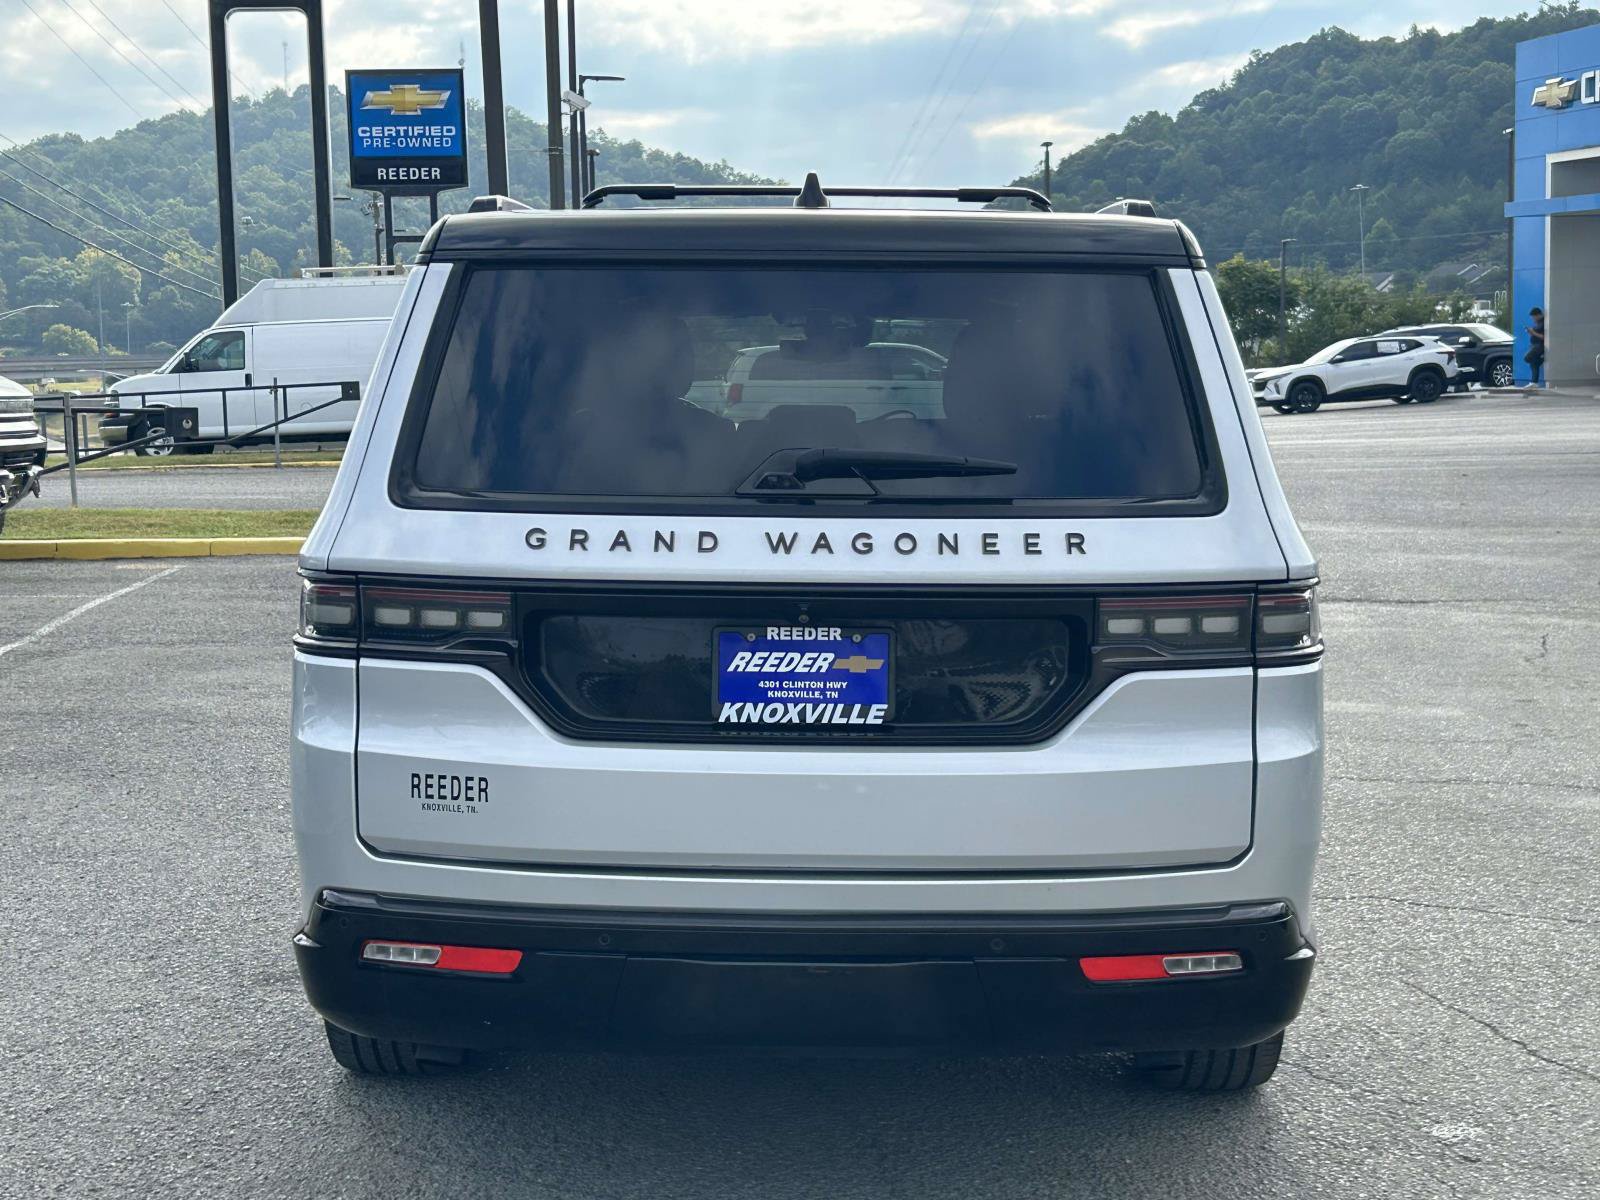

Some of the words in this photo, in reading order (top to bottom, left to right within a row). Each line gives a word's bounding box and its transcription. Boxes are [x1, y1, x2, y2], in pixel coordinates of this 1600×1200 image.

[358, 126, 456, 137] CERTIFIED
[363, 137, 452, 148] PRE-OWNED
[377, 167, 441, 180] REEDER
[525, 527, 719, 553] GRAND
[764, 531, 1087, 555] WAGONEER
[766, 627, 842, 641] REEDER
[727, 652, 835, 673] REEDER
[758, 681, 780, 689] 4301
[782, 681, 824, 689] CLINTON
[826, 682, 848, 690] HWY
[767, 690, 823, 699] KNOXVILLE,
[825, 691, 839, 699] TN
[718, 702, 888, 725] KNOXVILLE
[411, 773, 489, 802] REEDER
[422, 803, 465, 814] KNOXVILLE,
[466, 805, 479, 814] TN.
